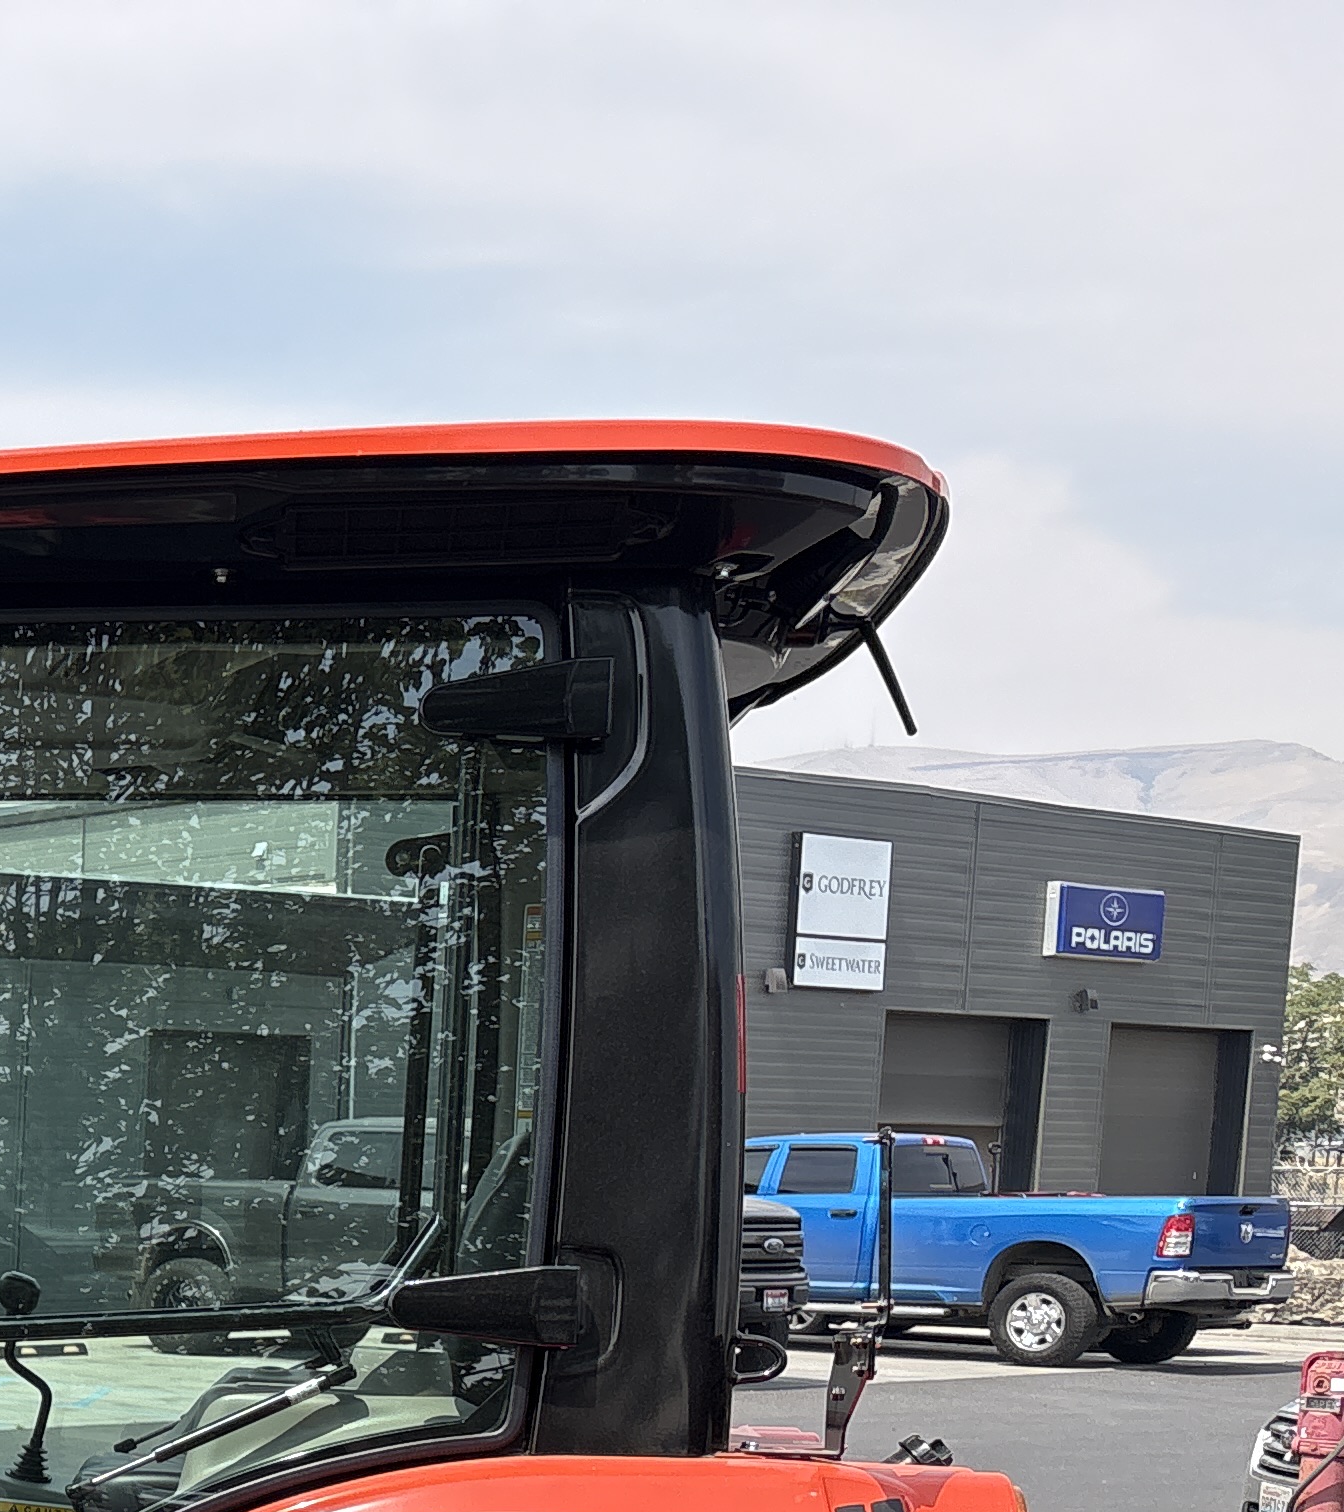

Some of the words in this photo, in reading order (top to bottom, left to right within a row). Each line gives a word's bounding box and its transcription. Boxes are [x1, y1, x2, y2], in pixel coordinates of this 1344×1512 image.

[818, 875, 887, 900] GODFREY
[1071, 926, 1154, 954] POLARIS
[809, 953, 881, 975] SWEETWATER
